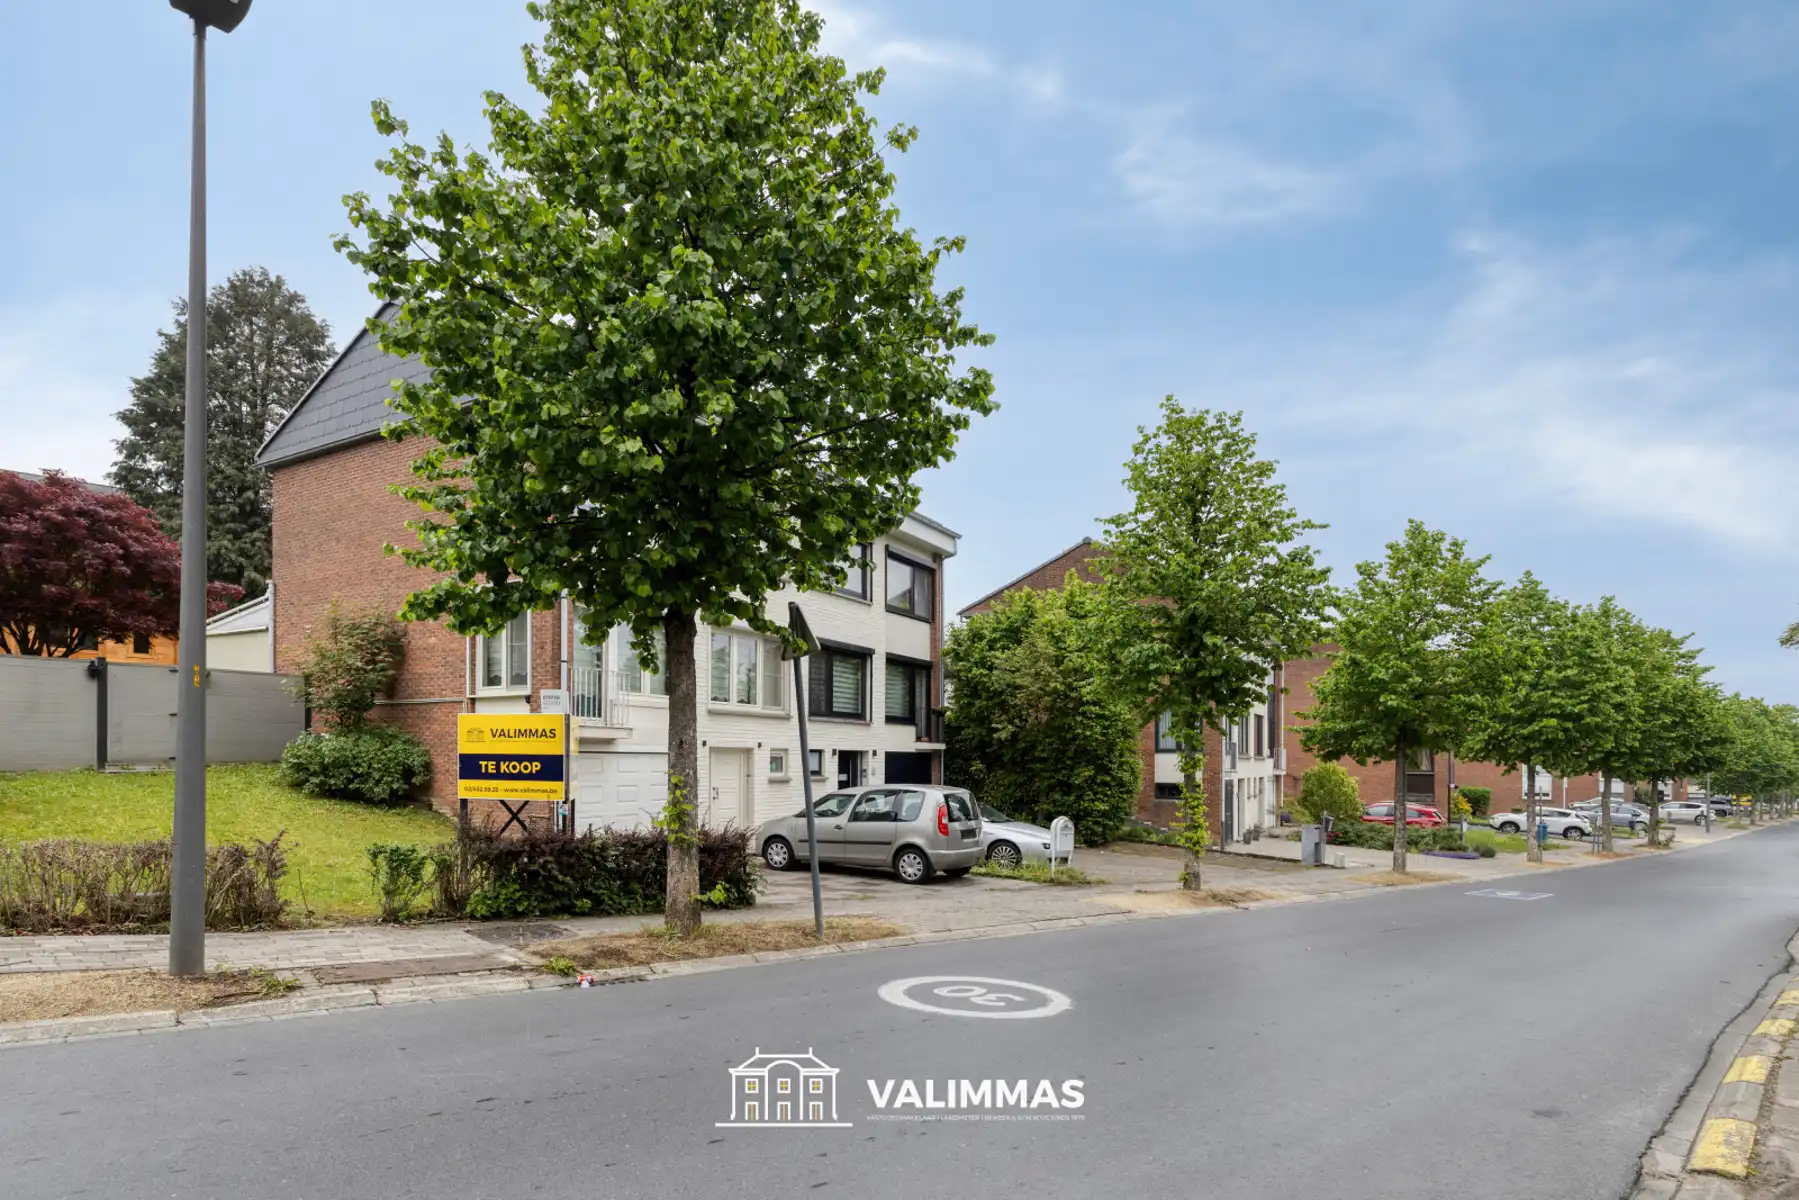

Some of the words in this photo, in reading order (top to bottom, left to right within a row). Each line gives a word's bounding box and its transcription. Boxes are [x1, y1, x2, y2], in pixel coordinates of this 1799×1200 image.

[490, 728, 557, 739] VALIMMAS
[479, 761, 497, 773] TE
[500, 761, 541, 774] KOOP
[503, 786, 558, 794] www.valimmas.be
